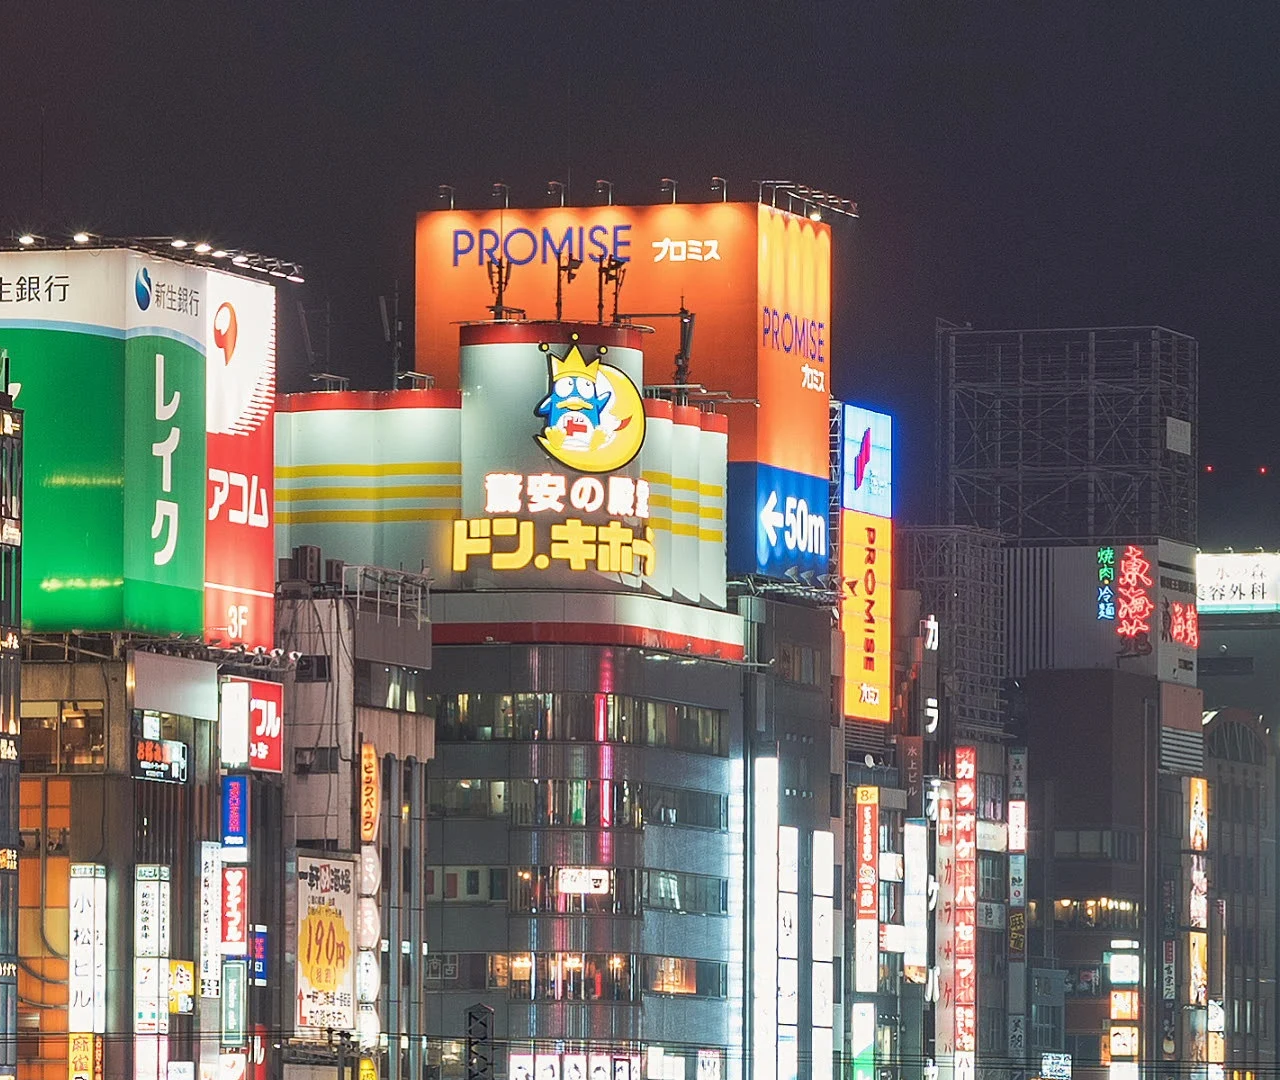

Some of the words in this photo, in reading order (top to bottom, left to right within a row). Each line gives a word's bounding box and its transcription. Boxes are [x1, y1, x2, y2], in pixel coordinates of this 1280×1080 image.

[452, 224, 631, 267] PROMISE
[651, 238, 721, 262] プロミス
[154, 282, 200, 317] 新生銀行
[762, 305, 826, 363] PROMISE
[151, 353, 182, 567] レイク
[207, 468, 270, 528] アコム
[784, 497, 827, 557] 50m
[227, 604, 249, 638] 3F
[863, 526, 877, 673] PROMISE
[306, 917, 346, 968] 190円
